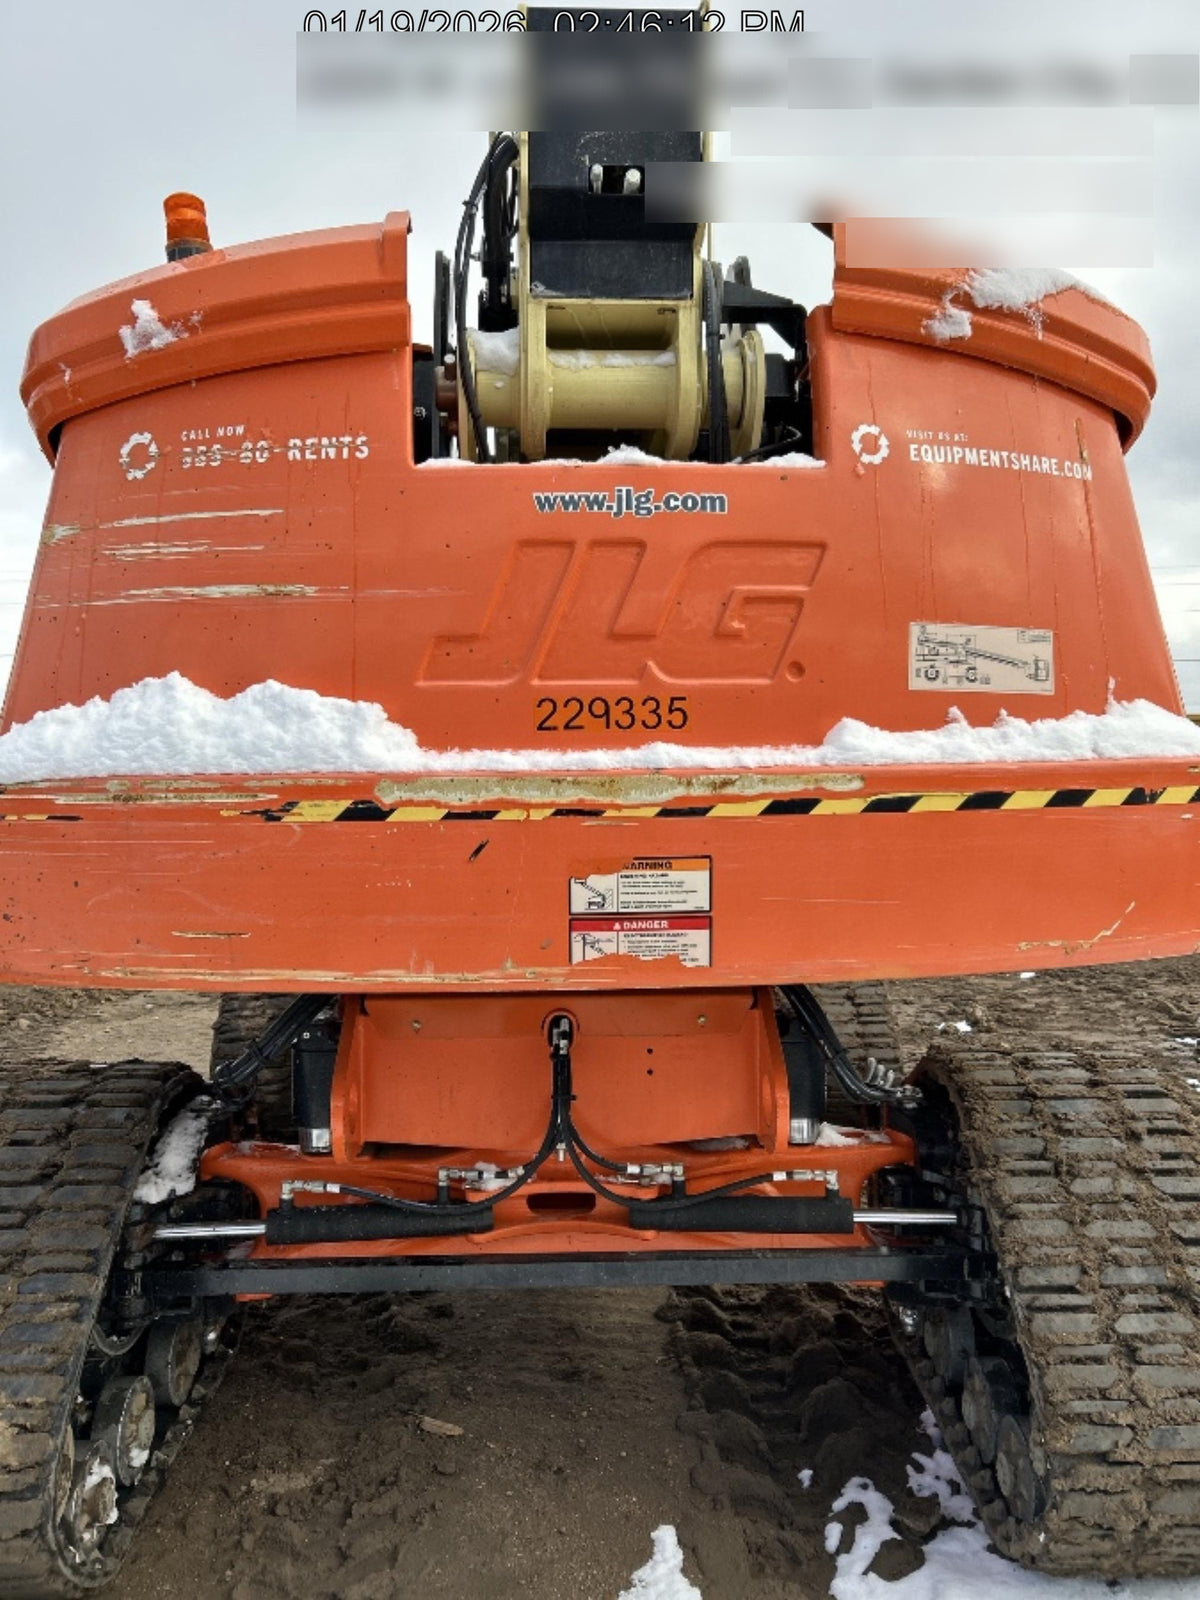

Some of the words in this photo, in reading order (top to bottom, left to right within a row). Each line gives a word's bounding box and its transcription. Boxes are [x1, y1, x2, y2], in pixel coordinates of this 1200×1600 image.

[181, 428, 211, 442] CALL
[216, 424, 246, 438] NOW
[906, 429, 933, 440] VISIT
[909, 443, 1093, 481] EQUIPMENTSHARE.COM
[533, 487, 728, 518] www.jlg.com
[414, 537, 828, 687] JLG
[536, 697, 689, 730] 229335
[623, 920, 670, 929] DANGER
